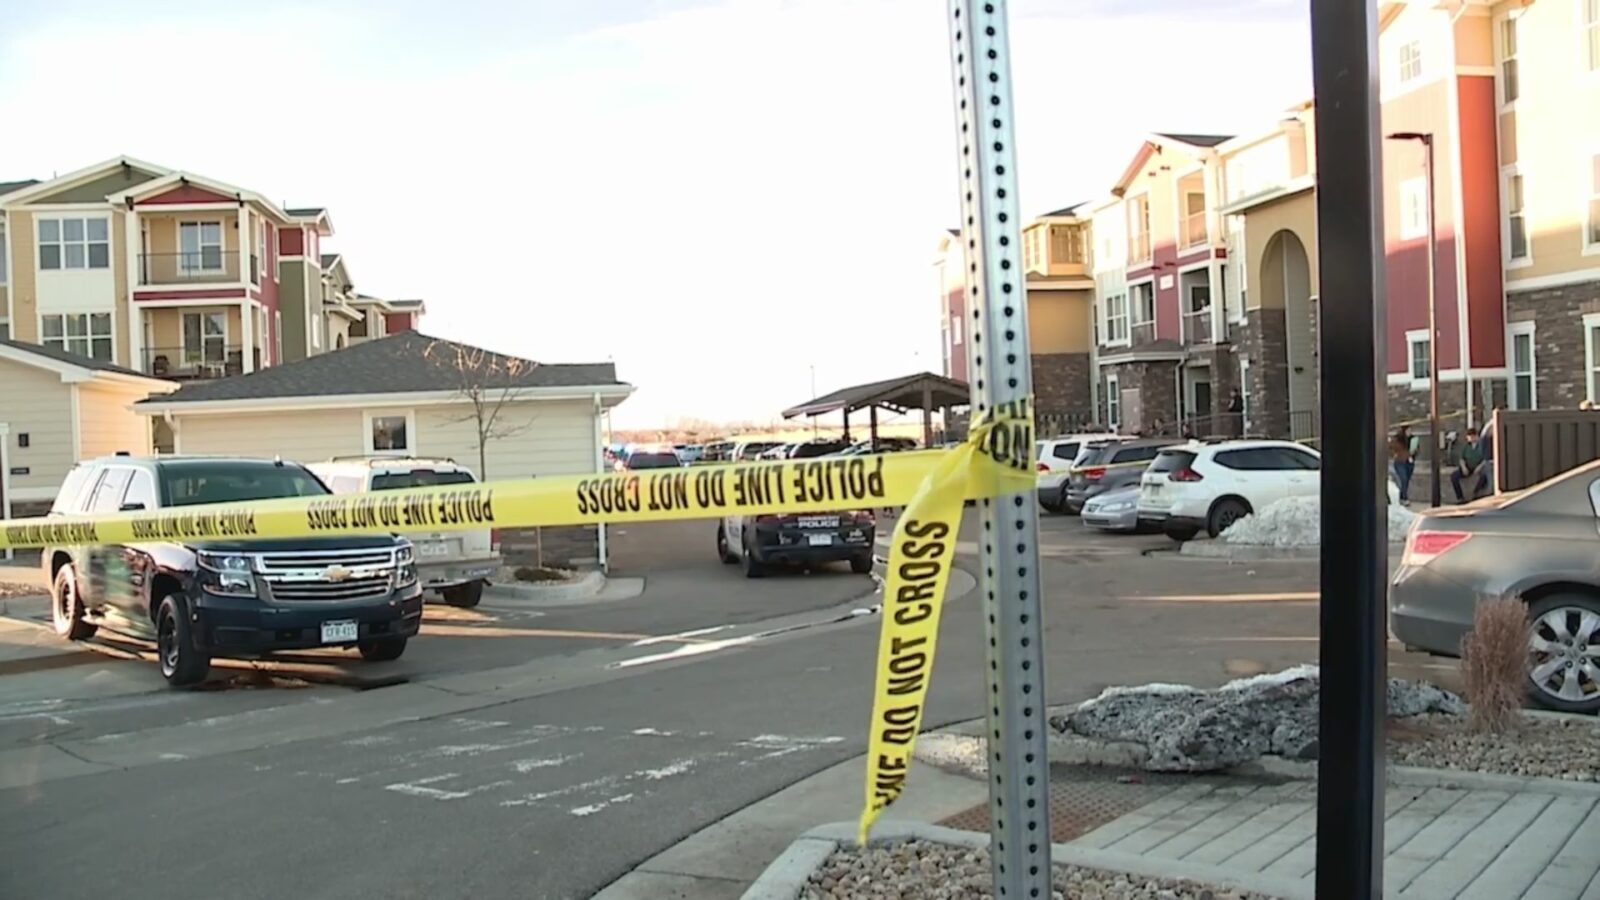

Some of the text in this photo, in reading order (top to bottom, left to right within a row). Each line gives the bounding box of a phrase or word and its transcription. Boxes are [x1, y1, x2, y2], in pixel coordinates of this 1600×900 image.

[577, 456, 885, 514] POLICE LINE DO NOT CROSS
[219, 511, 257, 535] POLICE
[307, 489, 494, 530] POLICE LINE DO NOT CROSS
[798, 520, 840, 528] POLICE
[894, 519, 950, 626] CROSS
[887, 636, 927, 695] NOT
[882, 704, 920, 744] DO
